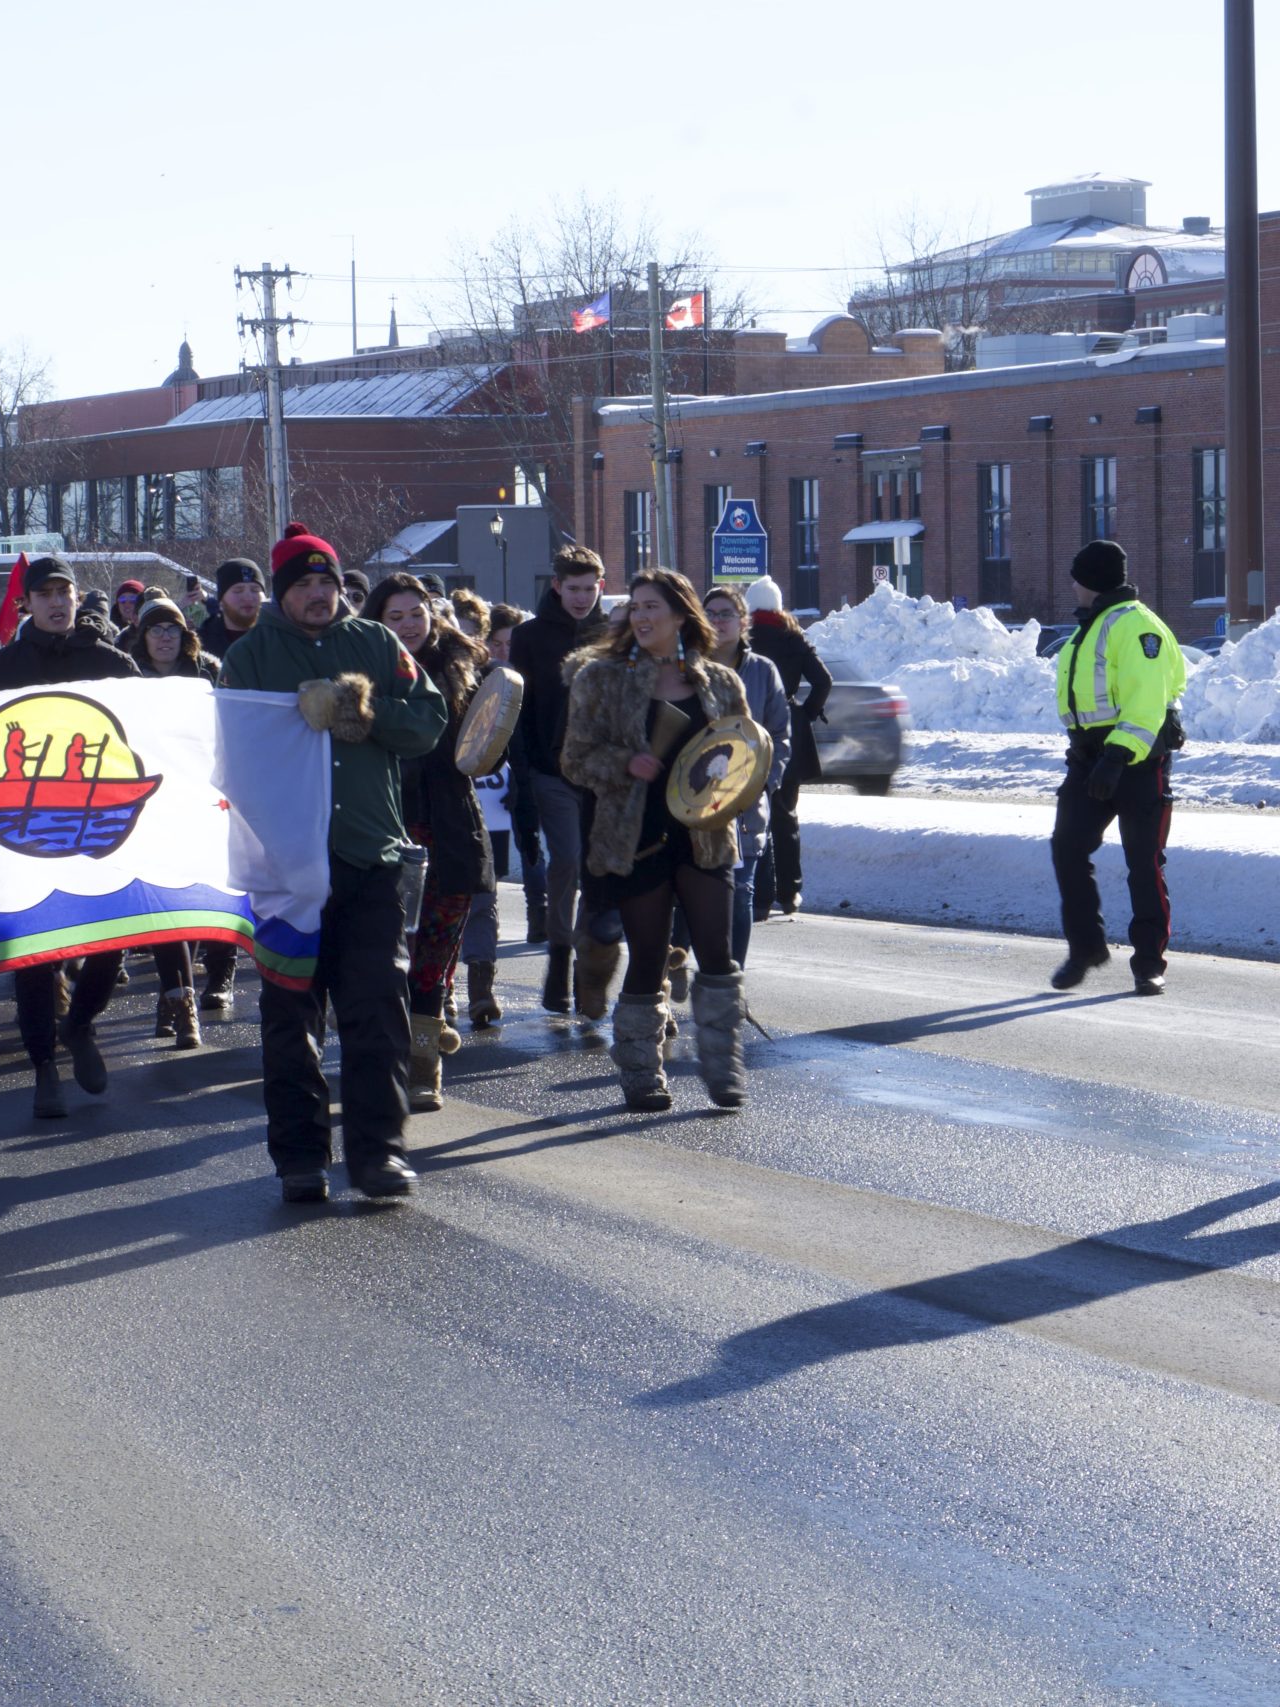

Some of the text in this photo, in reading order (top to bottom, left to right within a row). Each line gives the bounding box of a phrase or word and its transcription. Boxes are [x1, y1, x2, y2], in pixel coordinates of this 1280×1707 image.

[721, 537, 759, 545] Downtown
[720, 546, 760, 554] Centre-ville
[724, 556, 756, 564] Welcome
[721, 565, 759, 573] Bienvenue
